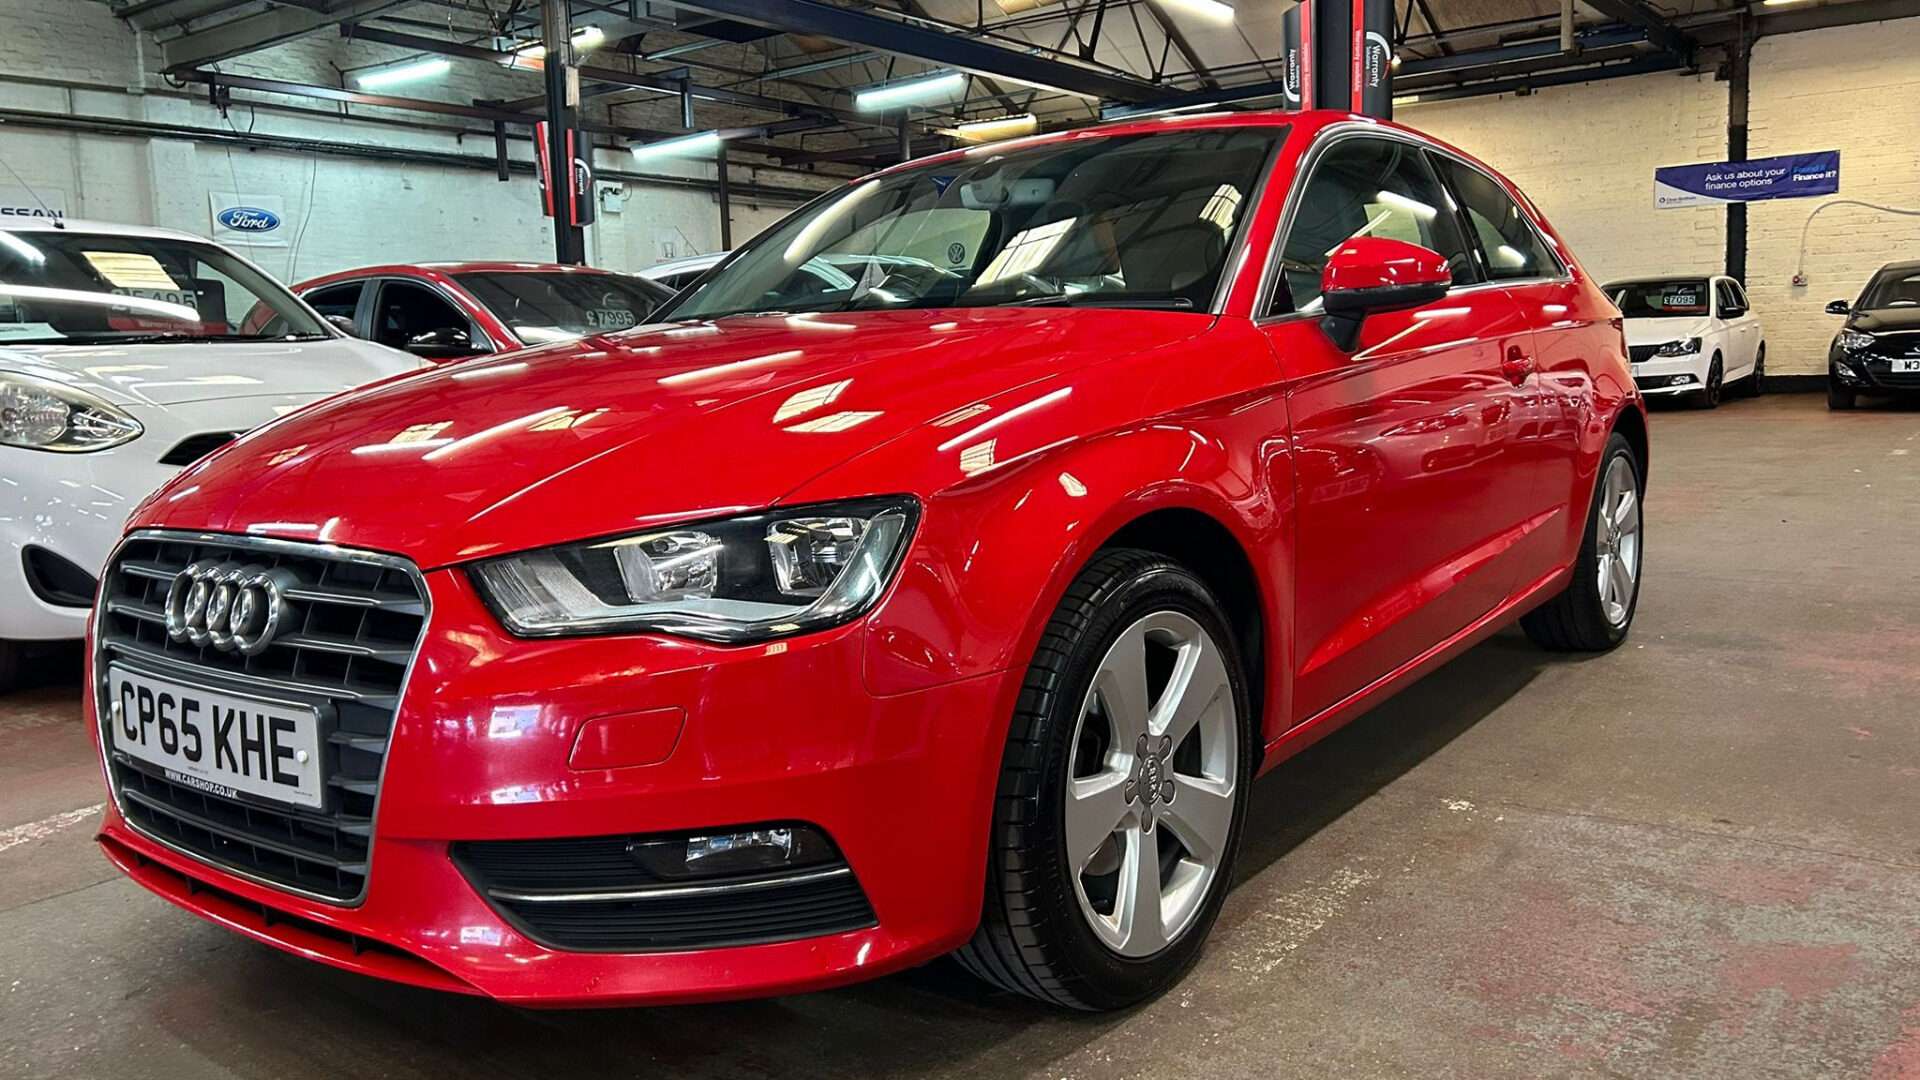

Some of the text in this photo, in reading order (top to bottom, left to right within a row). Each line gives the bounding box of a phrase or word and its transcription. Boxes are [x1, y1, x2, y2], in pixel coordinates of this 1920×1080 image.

[1369, 45, 1380, 88] Warranty
[1705, 173, 1722, 182] Ask
[1737, 170, 1763, 179] about
[1765, 168, 1786, 177] your
[1792, 170, 1837, 181] Finance it?
[1705, 178, 1773, 190] finance options
[230, 210, 269, 228] Ford
[586, 310, 633, 326] £7995
[121, 680, 299, 787] CP65 KHE
[164, 768, 239, 799] WWW.CARSHOP.CO.UK
